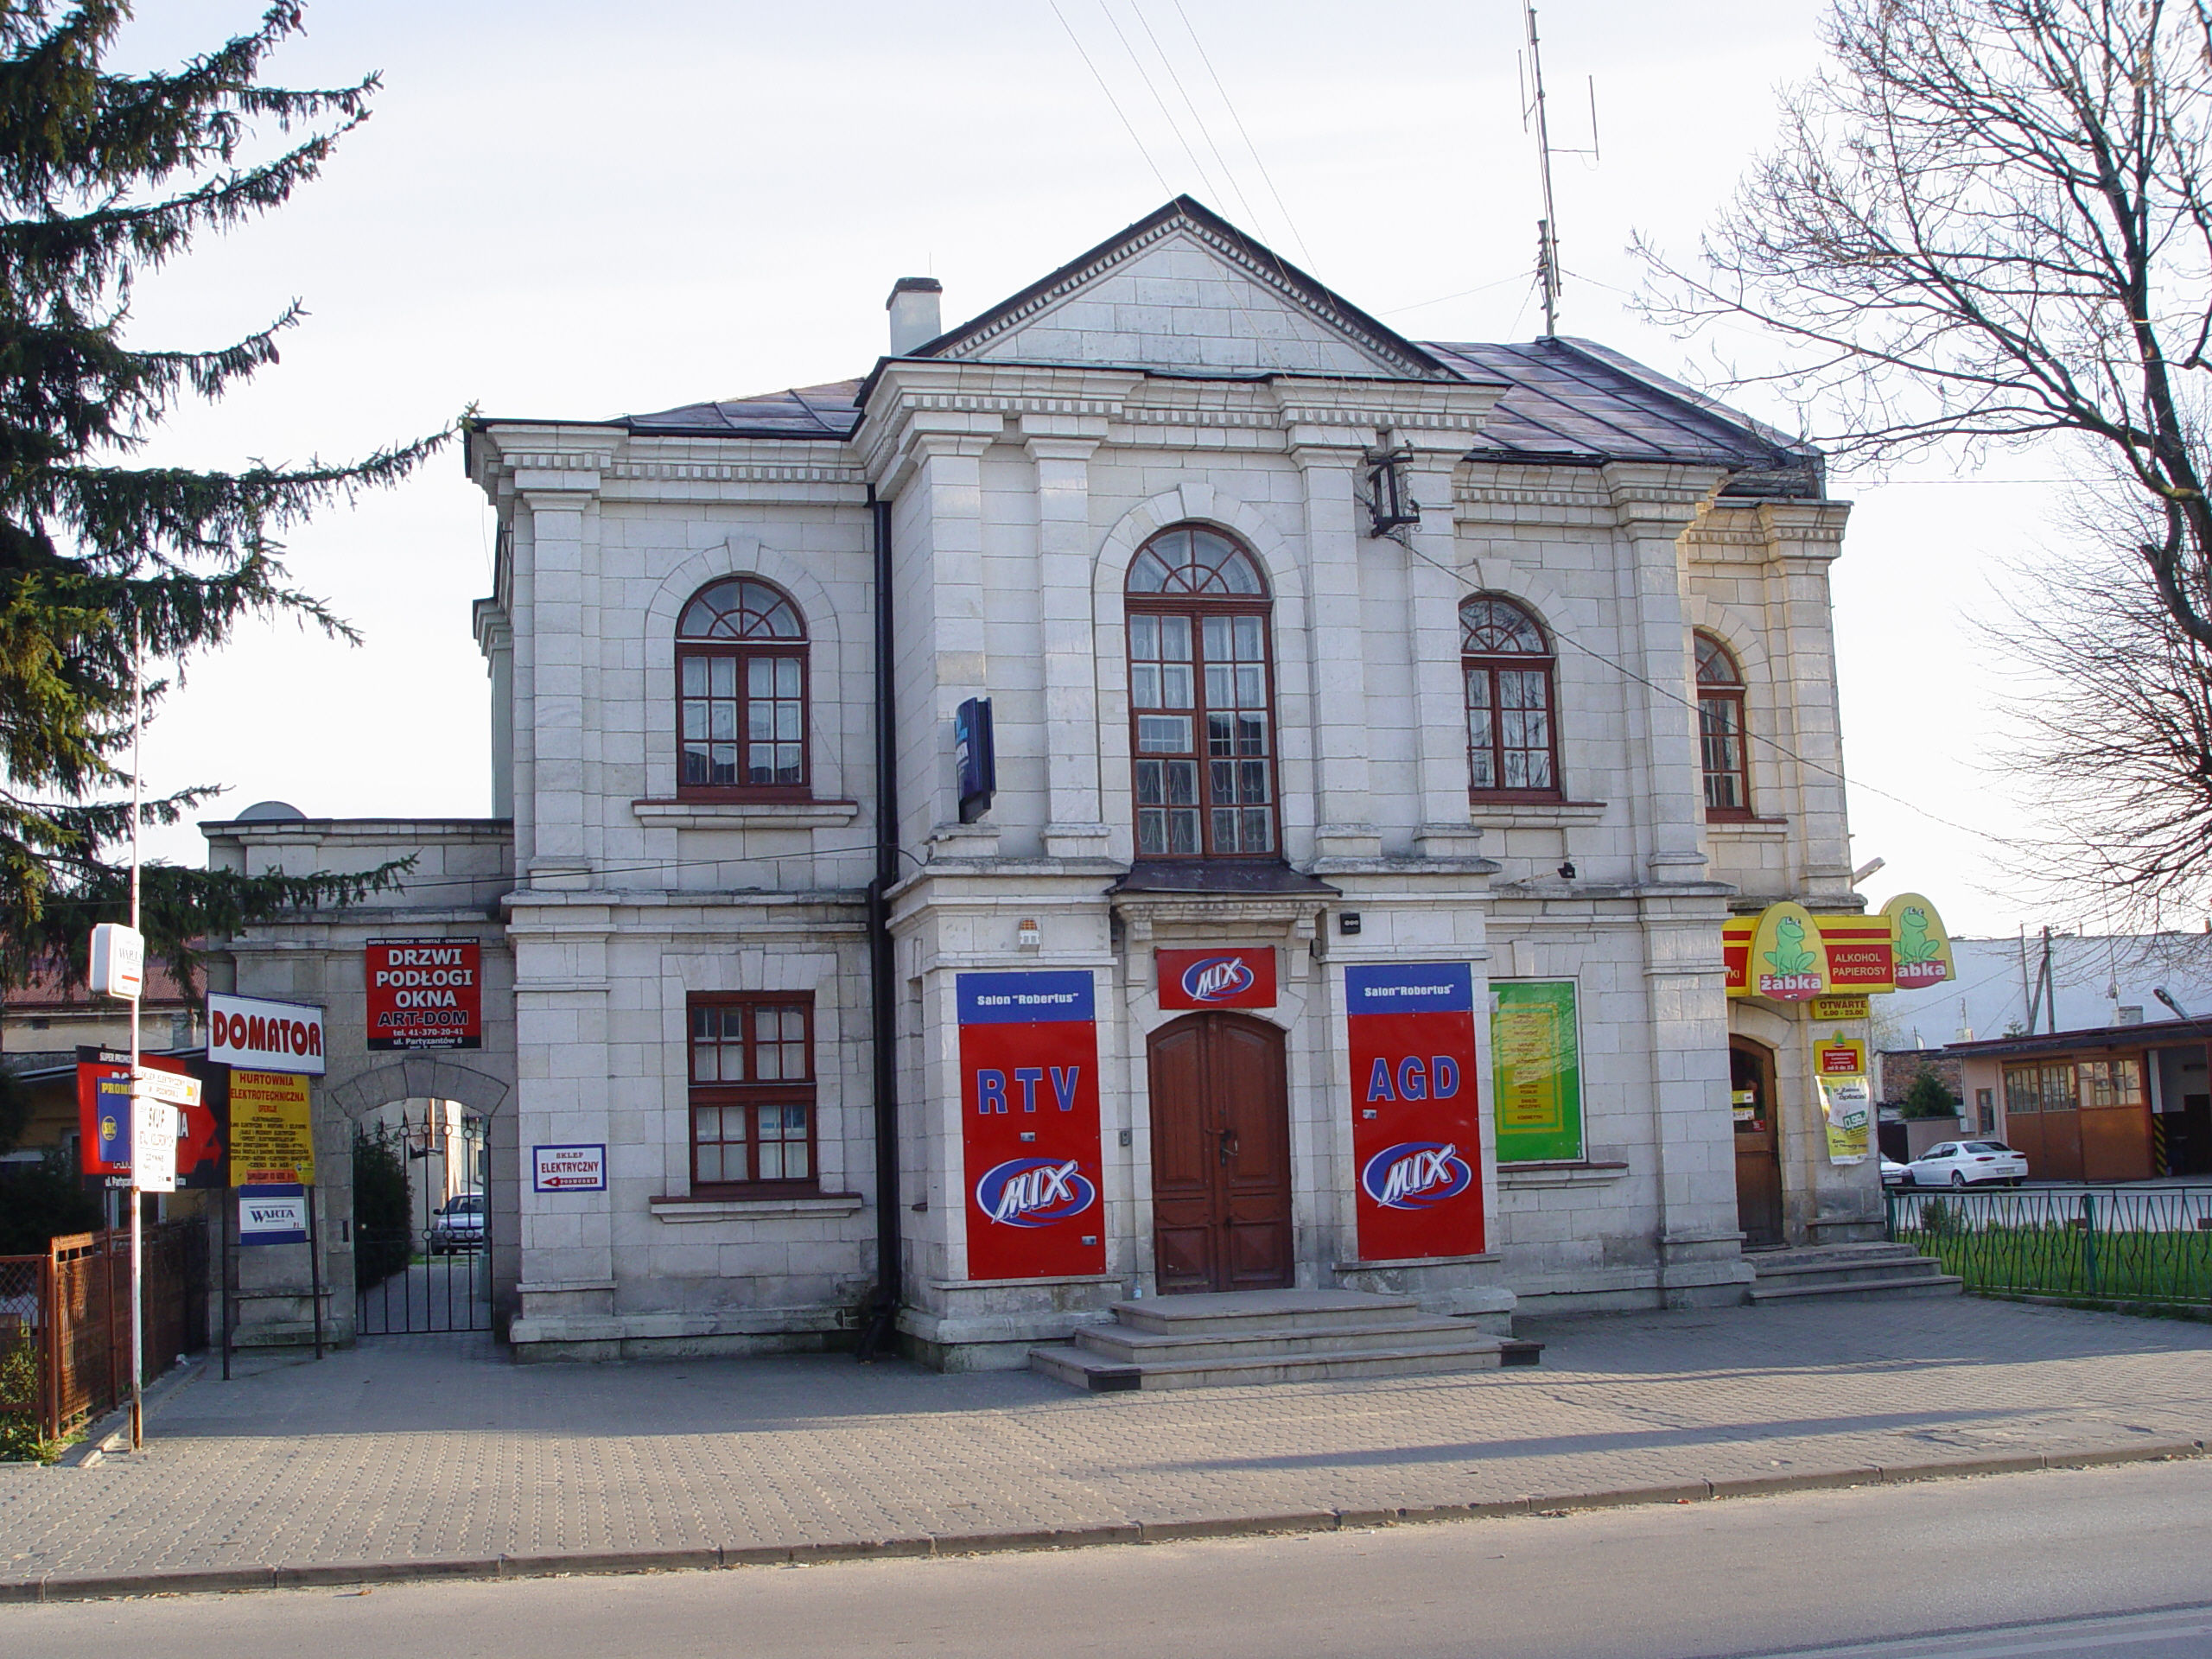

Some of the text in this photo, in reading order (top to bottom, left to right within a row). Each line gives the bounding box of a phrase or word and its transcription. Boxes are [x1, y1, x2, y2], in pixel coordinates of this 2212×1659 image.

[388, 948, 462, 966] DRZWI
[1834, 952, 1881, 963] ALKOHOL
[376, 969, 473, 988] PODŁOGI
[1192, 956, 1243, 1001] MIX
[1832, 966, 1887, 977] PAPIEROSY
[1760, 976, 1822, 991] żabka
[395, 989, 457, 1008] OKNA
[1364, 987, 1395, 997] Salon
[976, 995, 1011, 1006] Salon
[1819, 1000, 1866, 1009] OTWARTE
[378, 1010, 468, 1027] ART-DOM
[213, 1010, 321, 1057] DOMATOR
[405, 1037, 455, 1046] Partyzantów
[239, 1072, 295, 1086] HURTOWNIA
[1366, 1055, 1460, 1103] AGD
[228, 1088, 305, 1102] ELEKTROTECHNICZNA
[976, 1065, 1080, 1115] RTV
[541, 1161, 600, 1173] ELEKTRYCZNY
[1376, 1142, 1456, 1208] MIX
[990, 1159, 1078, 1225] MIX
[249, 1209, 296, 1224] WARTA
